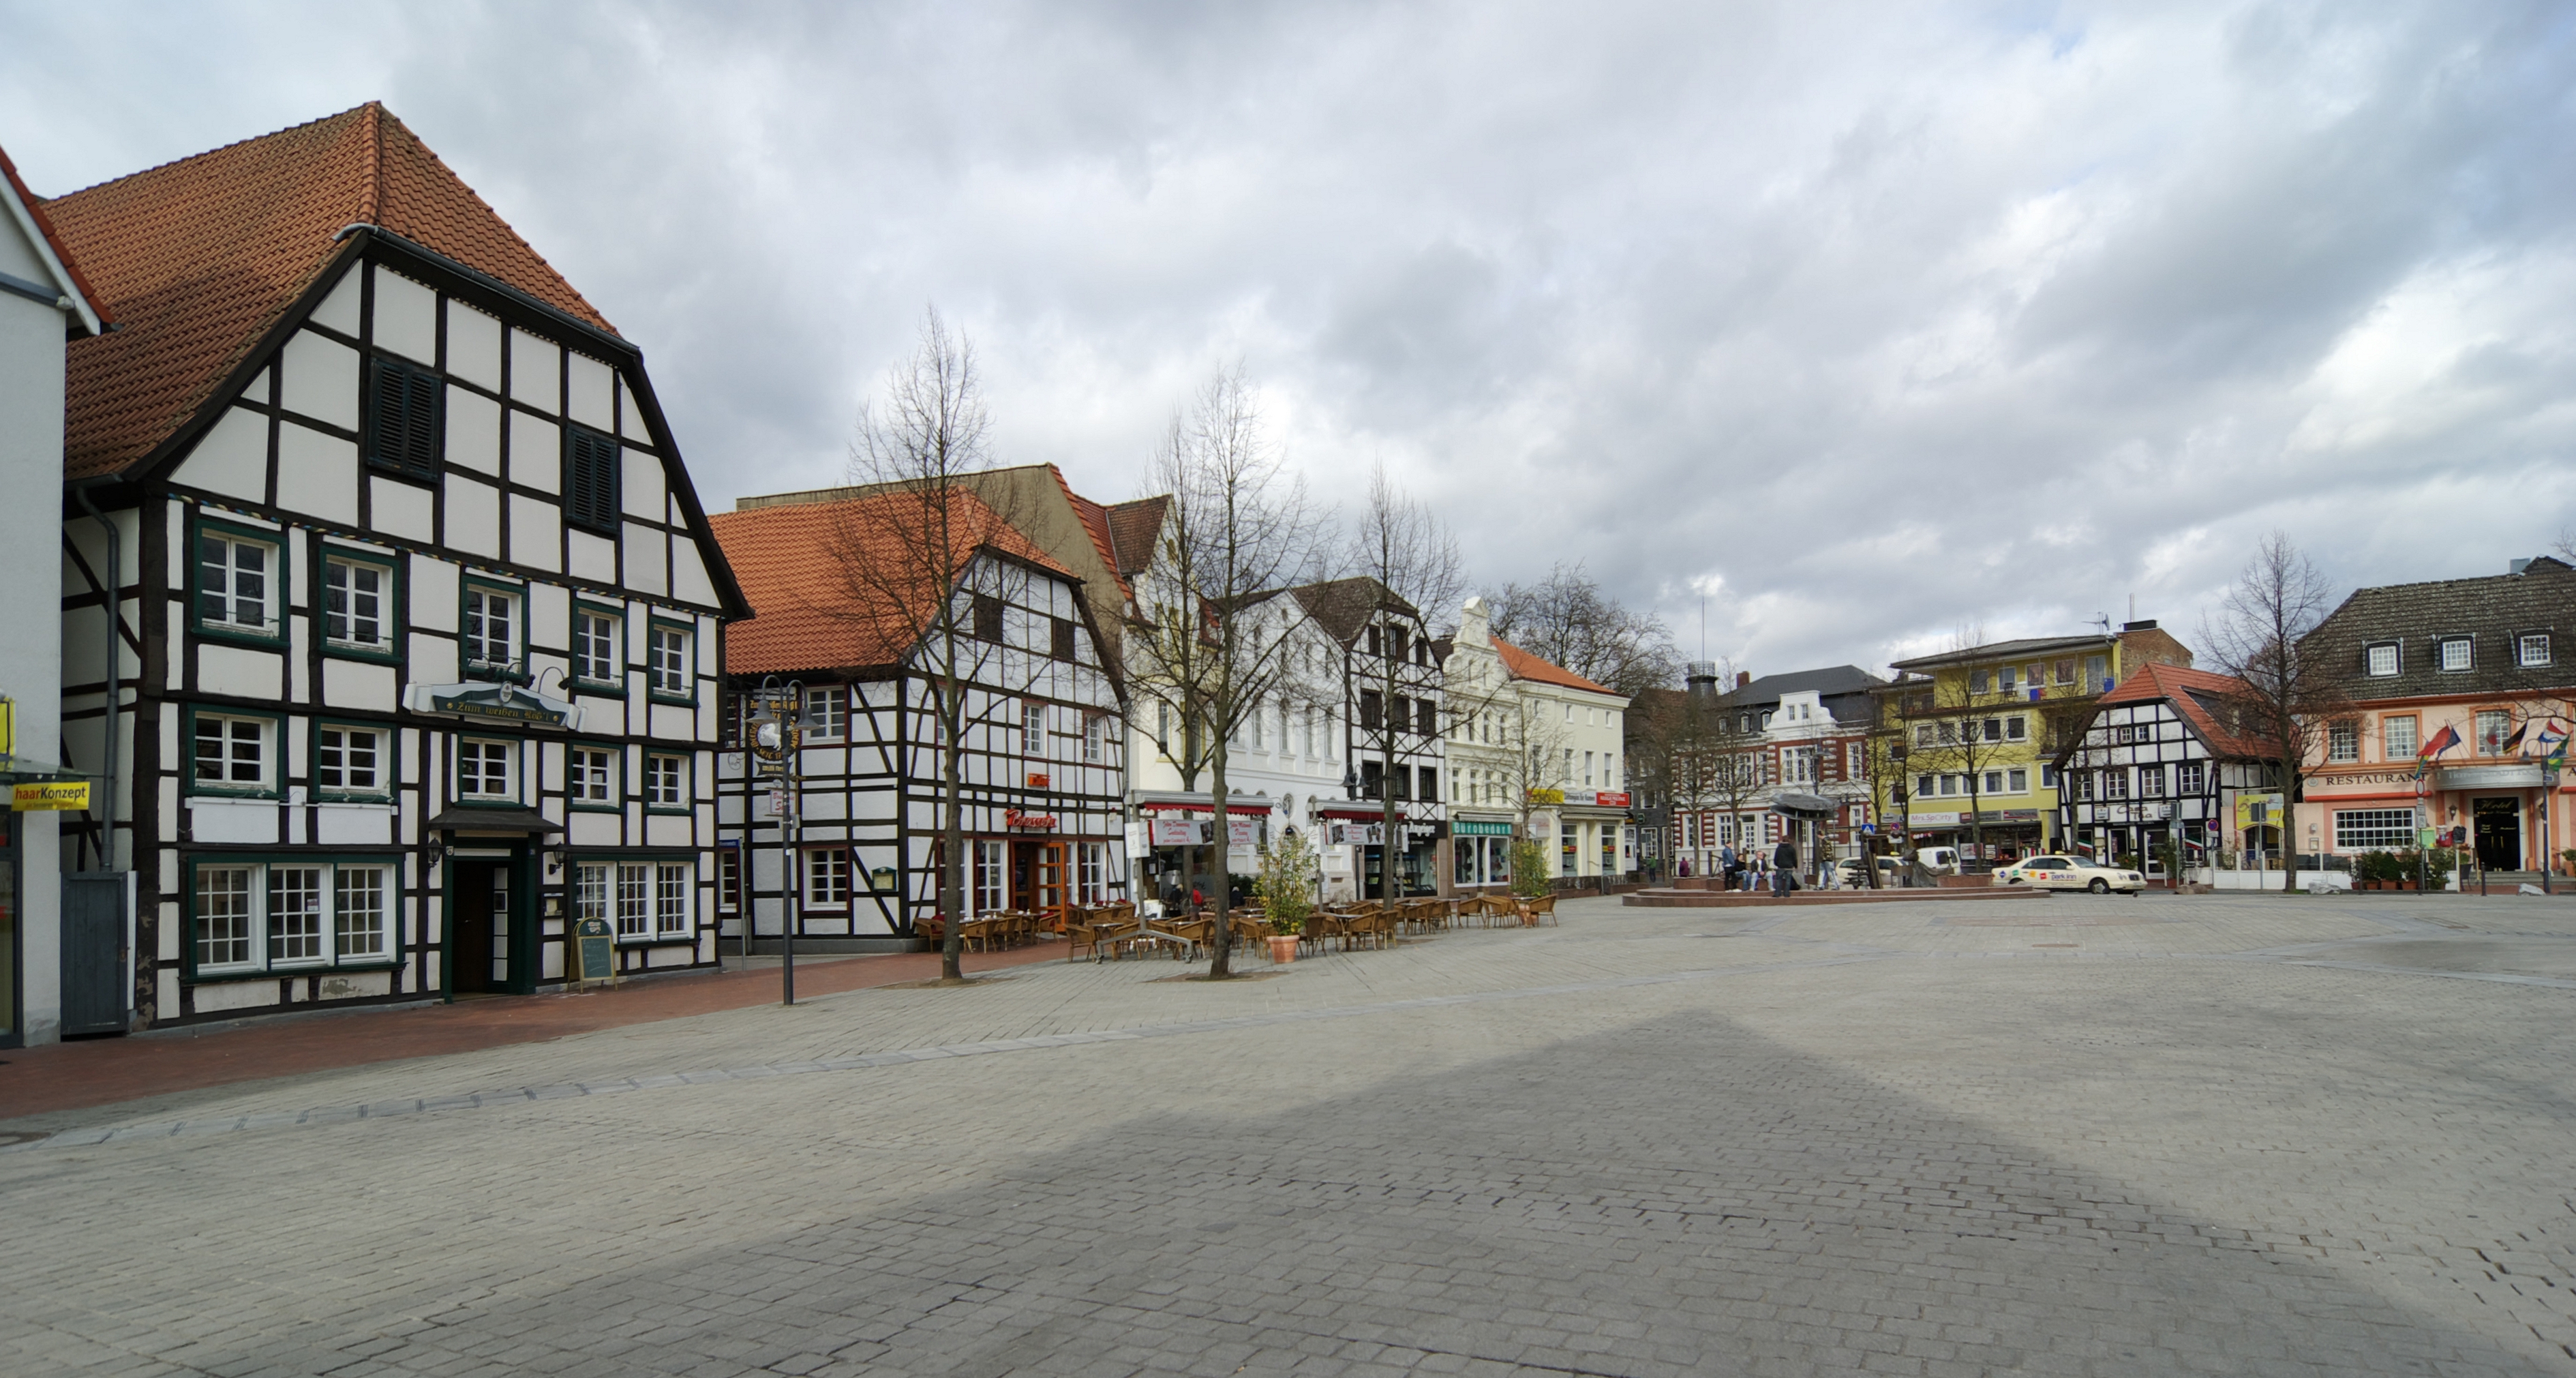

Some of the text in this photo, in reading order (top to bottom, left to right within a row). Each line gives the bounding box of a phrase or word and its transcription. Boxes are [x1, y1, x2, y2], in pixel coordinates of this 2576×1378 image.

[457, 702, 481, 713] Zum
[485, 705, 519, 718] weißen
[2326, 773, 2428, 786] RESTAURANT
[15, 786, 87, 801] haarKonzept
[2117, 805, 2149, 815] Casa
